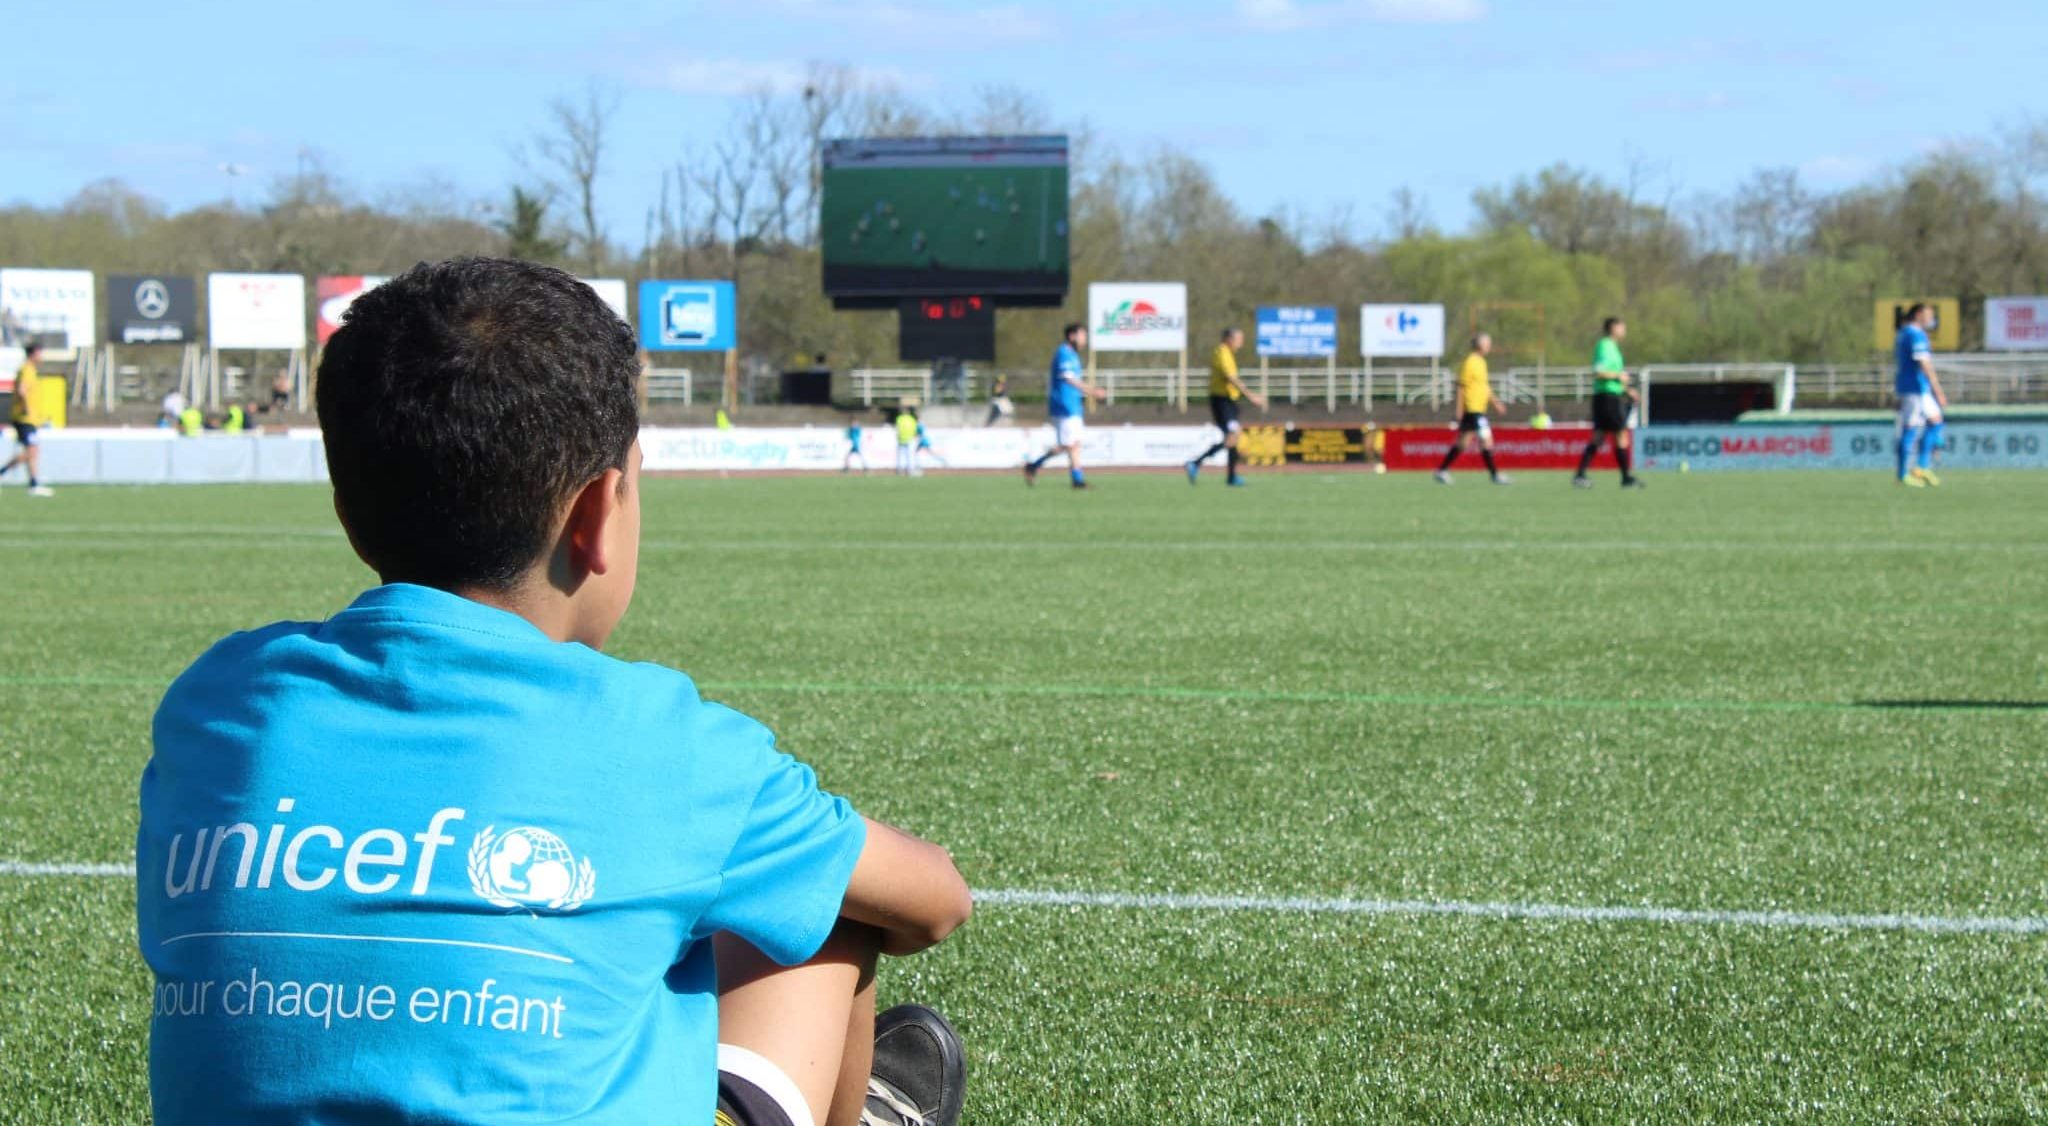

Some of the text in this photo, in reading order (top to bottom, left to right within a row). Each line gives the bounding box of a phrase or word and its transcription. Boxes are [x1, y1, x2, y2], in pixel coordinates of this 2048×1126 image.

[165, 798, 466, 898] unicef
[223, 967, 396, 1030] chaque
[409, 978, 567, 1039] enfant
